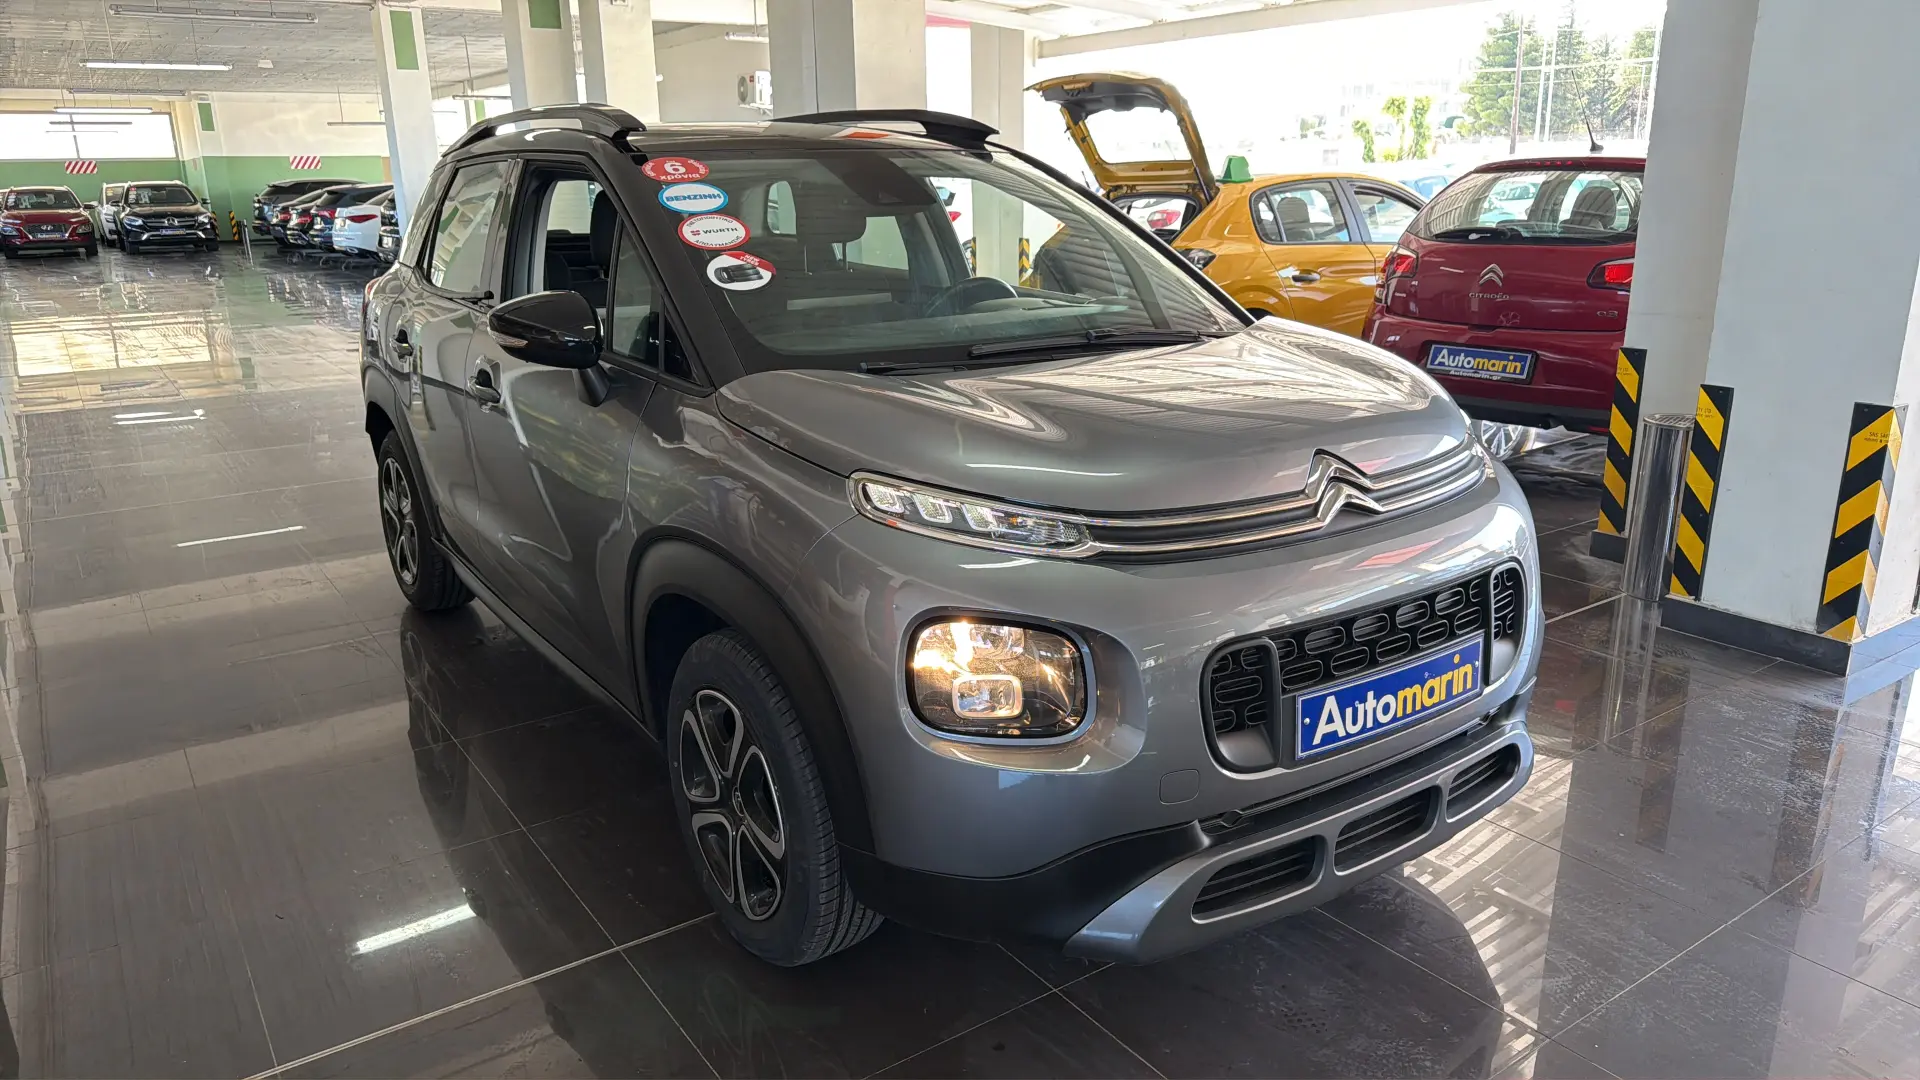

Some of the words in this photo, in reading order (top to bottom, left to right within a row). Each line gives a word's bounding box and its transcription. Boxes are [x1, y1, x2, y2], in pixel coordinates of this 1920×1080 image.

[660, 173, 701, 181] χρόνια
[664, 162, 686, 175] 6
[1434, 348, 1521, 374] Automarin
[1312, 653, 1472, 746] Automarin
